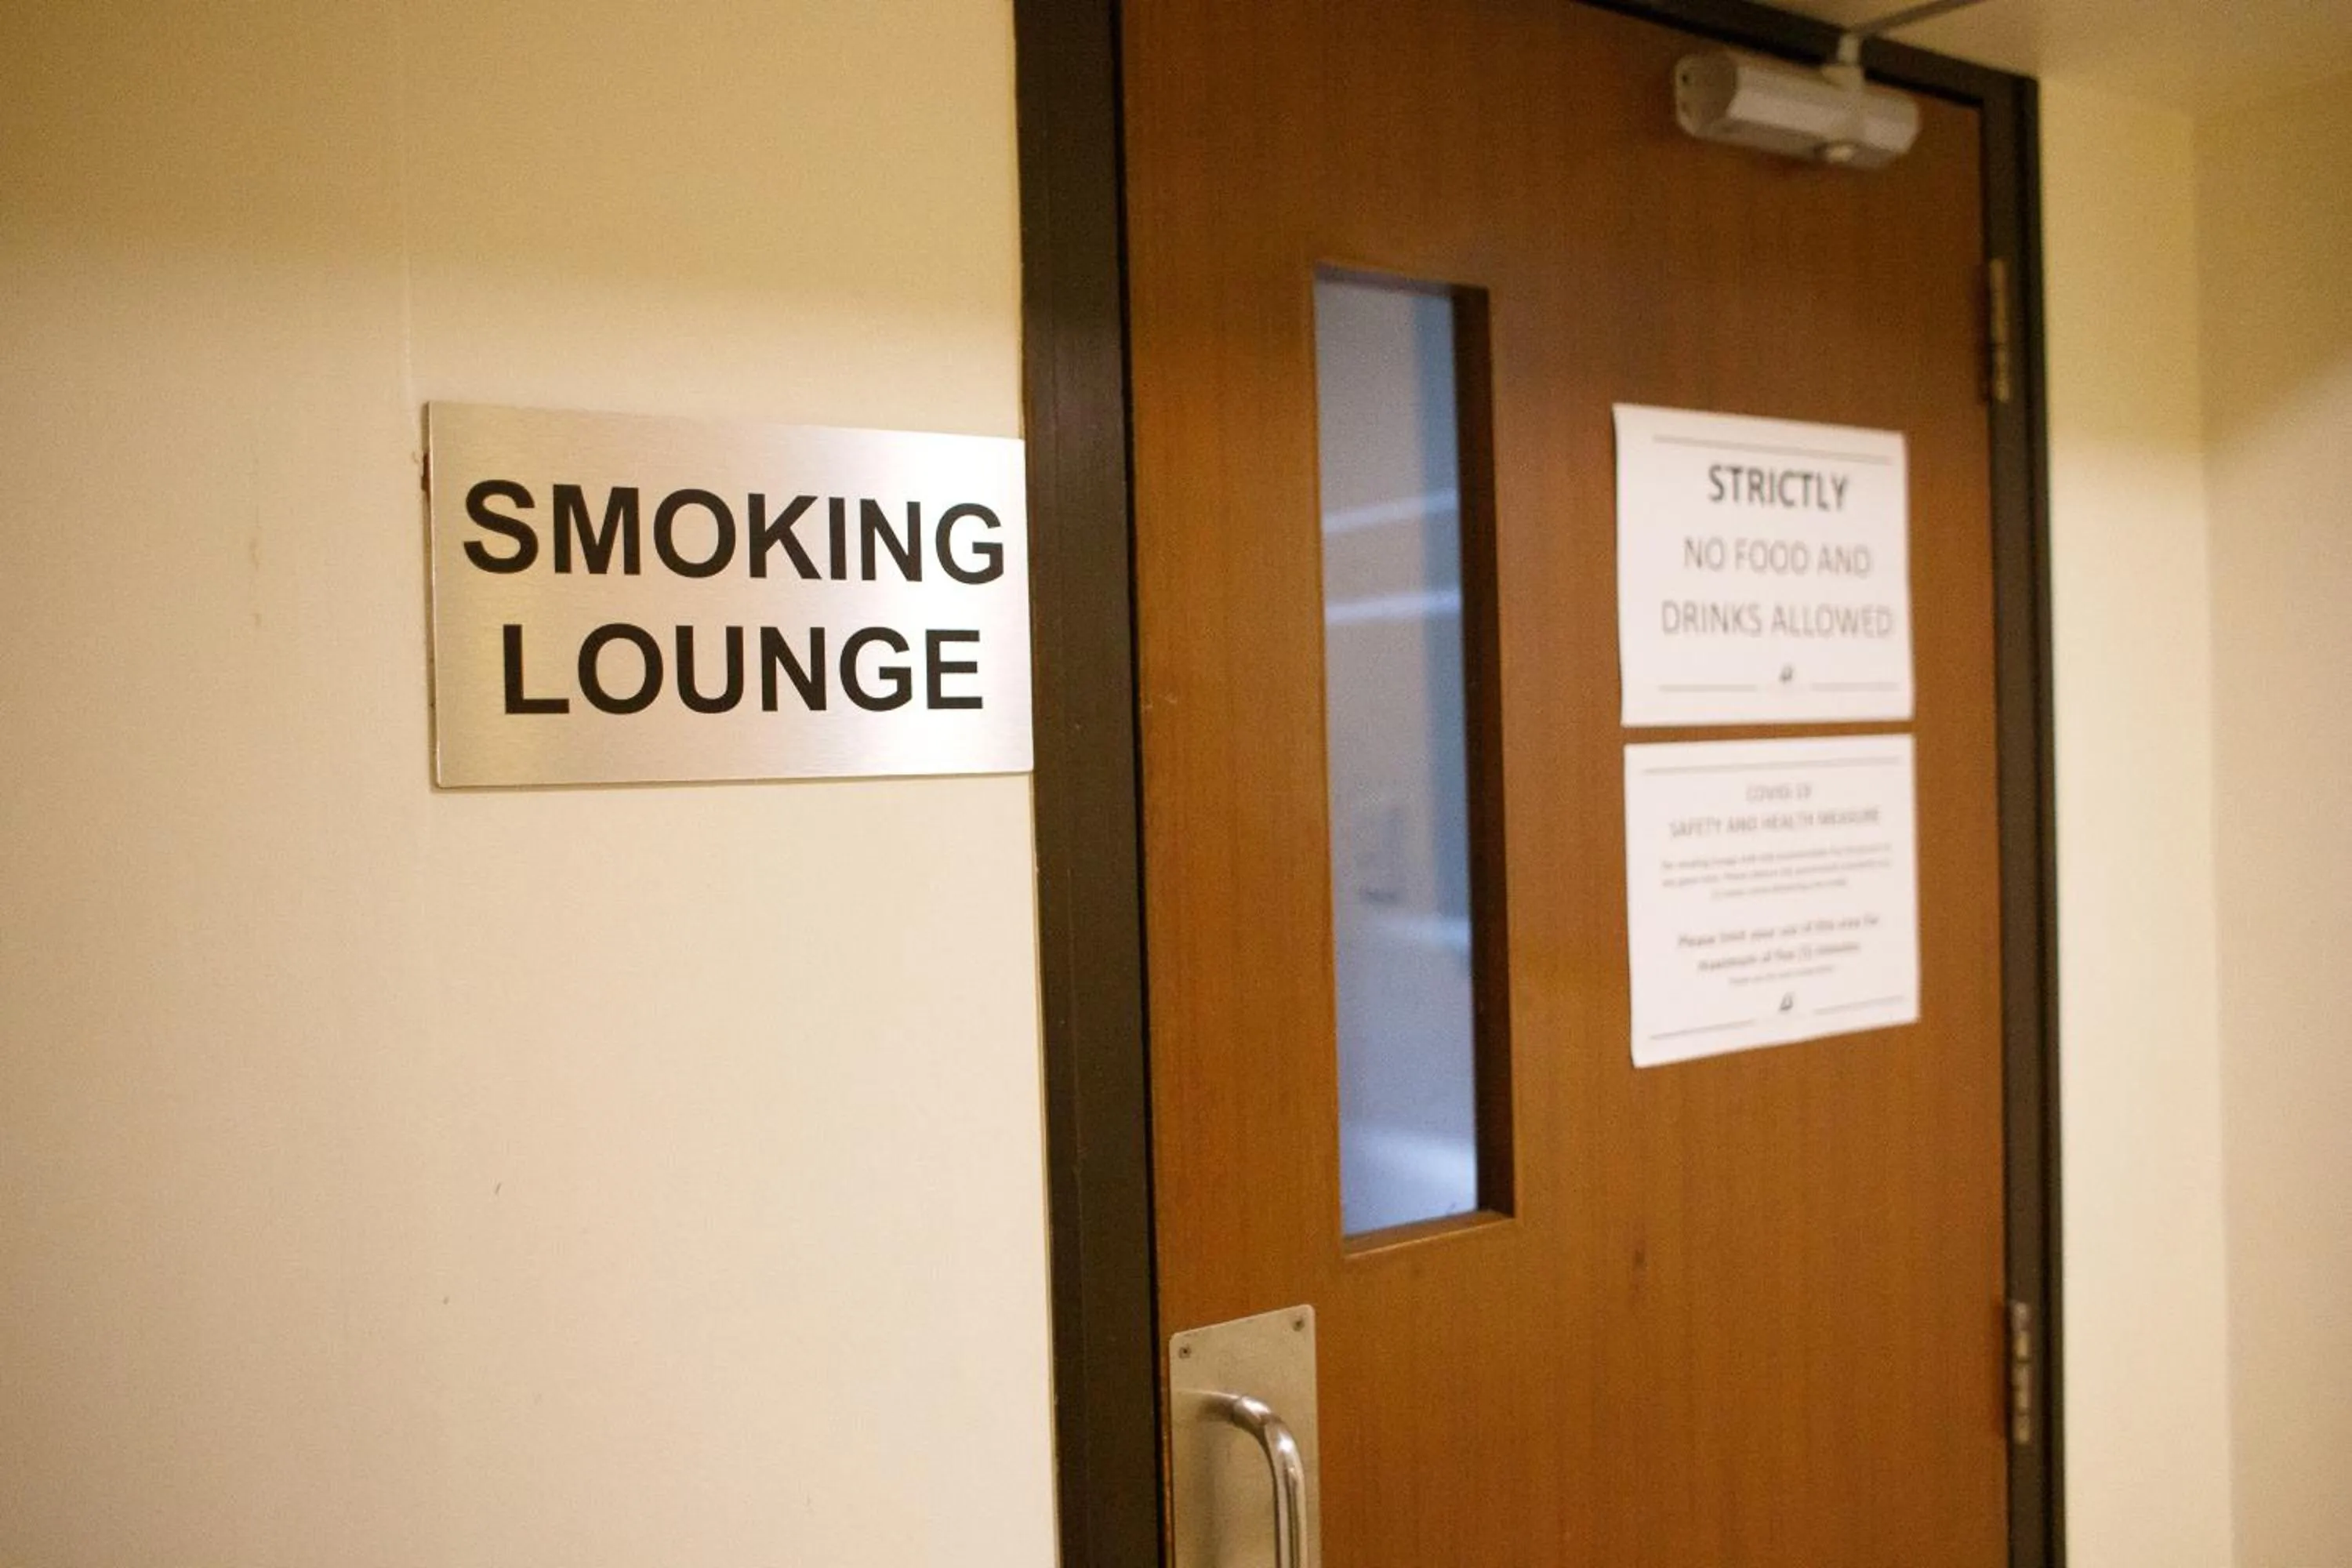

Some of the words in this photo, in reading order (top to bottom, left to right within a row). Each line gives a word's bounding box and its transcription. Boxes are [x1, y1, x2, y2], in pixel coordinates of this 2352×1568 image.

[1709, 464, 1849, 510] STRICTLY
[463, 479, 1004, 585] SMOKING
[1683, 536, 1725, 572] NO
[1734, 538, 1809, 575] FOOD
[1817, 545, 1871, 579] AND
[1661, 600, 1762, 637] DRINKS
[1770, 604, 1893, 638] ALLOWED
[502, 623, 983, 715] LOUNGE
